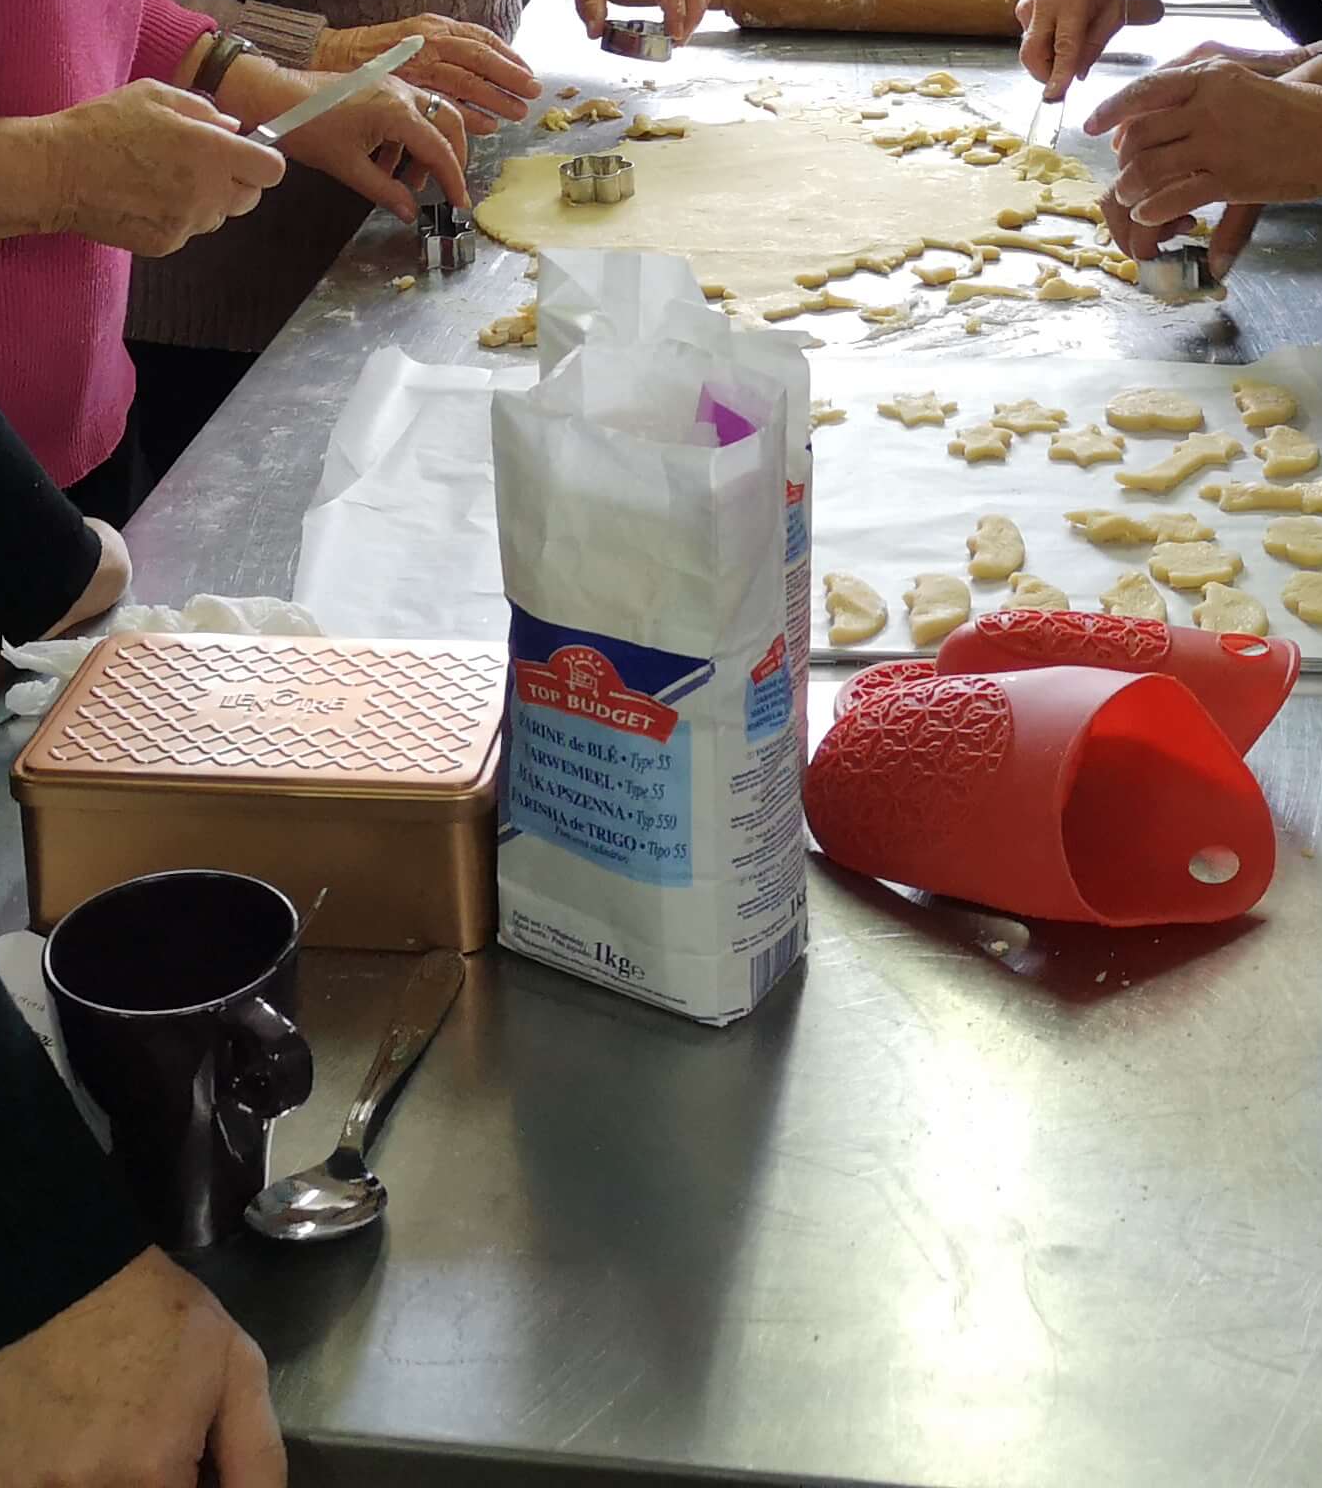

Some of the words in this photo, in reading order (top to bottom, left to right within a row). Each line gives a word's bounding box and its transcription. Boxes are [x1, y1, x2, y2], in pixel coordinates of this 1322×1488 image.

[527, 683, 561, 703] TOP
[567, 694, 655, 730] BUDGET
[569, 737, 584, 752] de
[587, 742, 618, 764] BLÉ
[631, 753, 652, 774] Type
[658, 754, 671, 770] 55
[625, 780, 648, 801] Type
[651, 784, 666, 799] 55
[570, 815, 584, 831] de
[585, 822, 637, 851] TRIGO
[647, 843, 670, 861] Tipo
[673, 845, 687, 859] 55
[636, 810, 654, 831] Typ
[656, 813, 677, 830] 550
